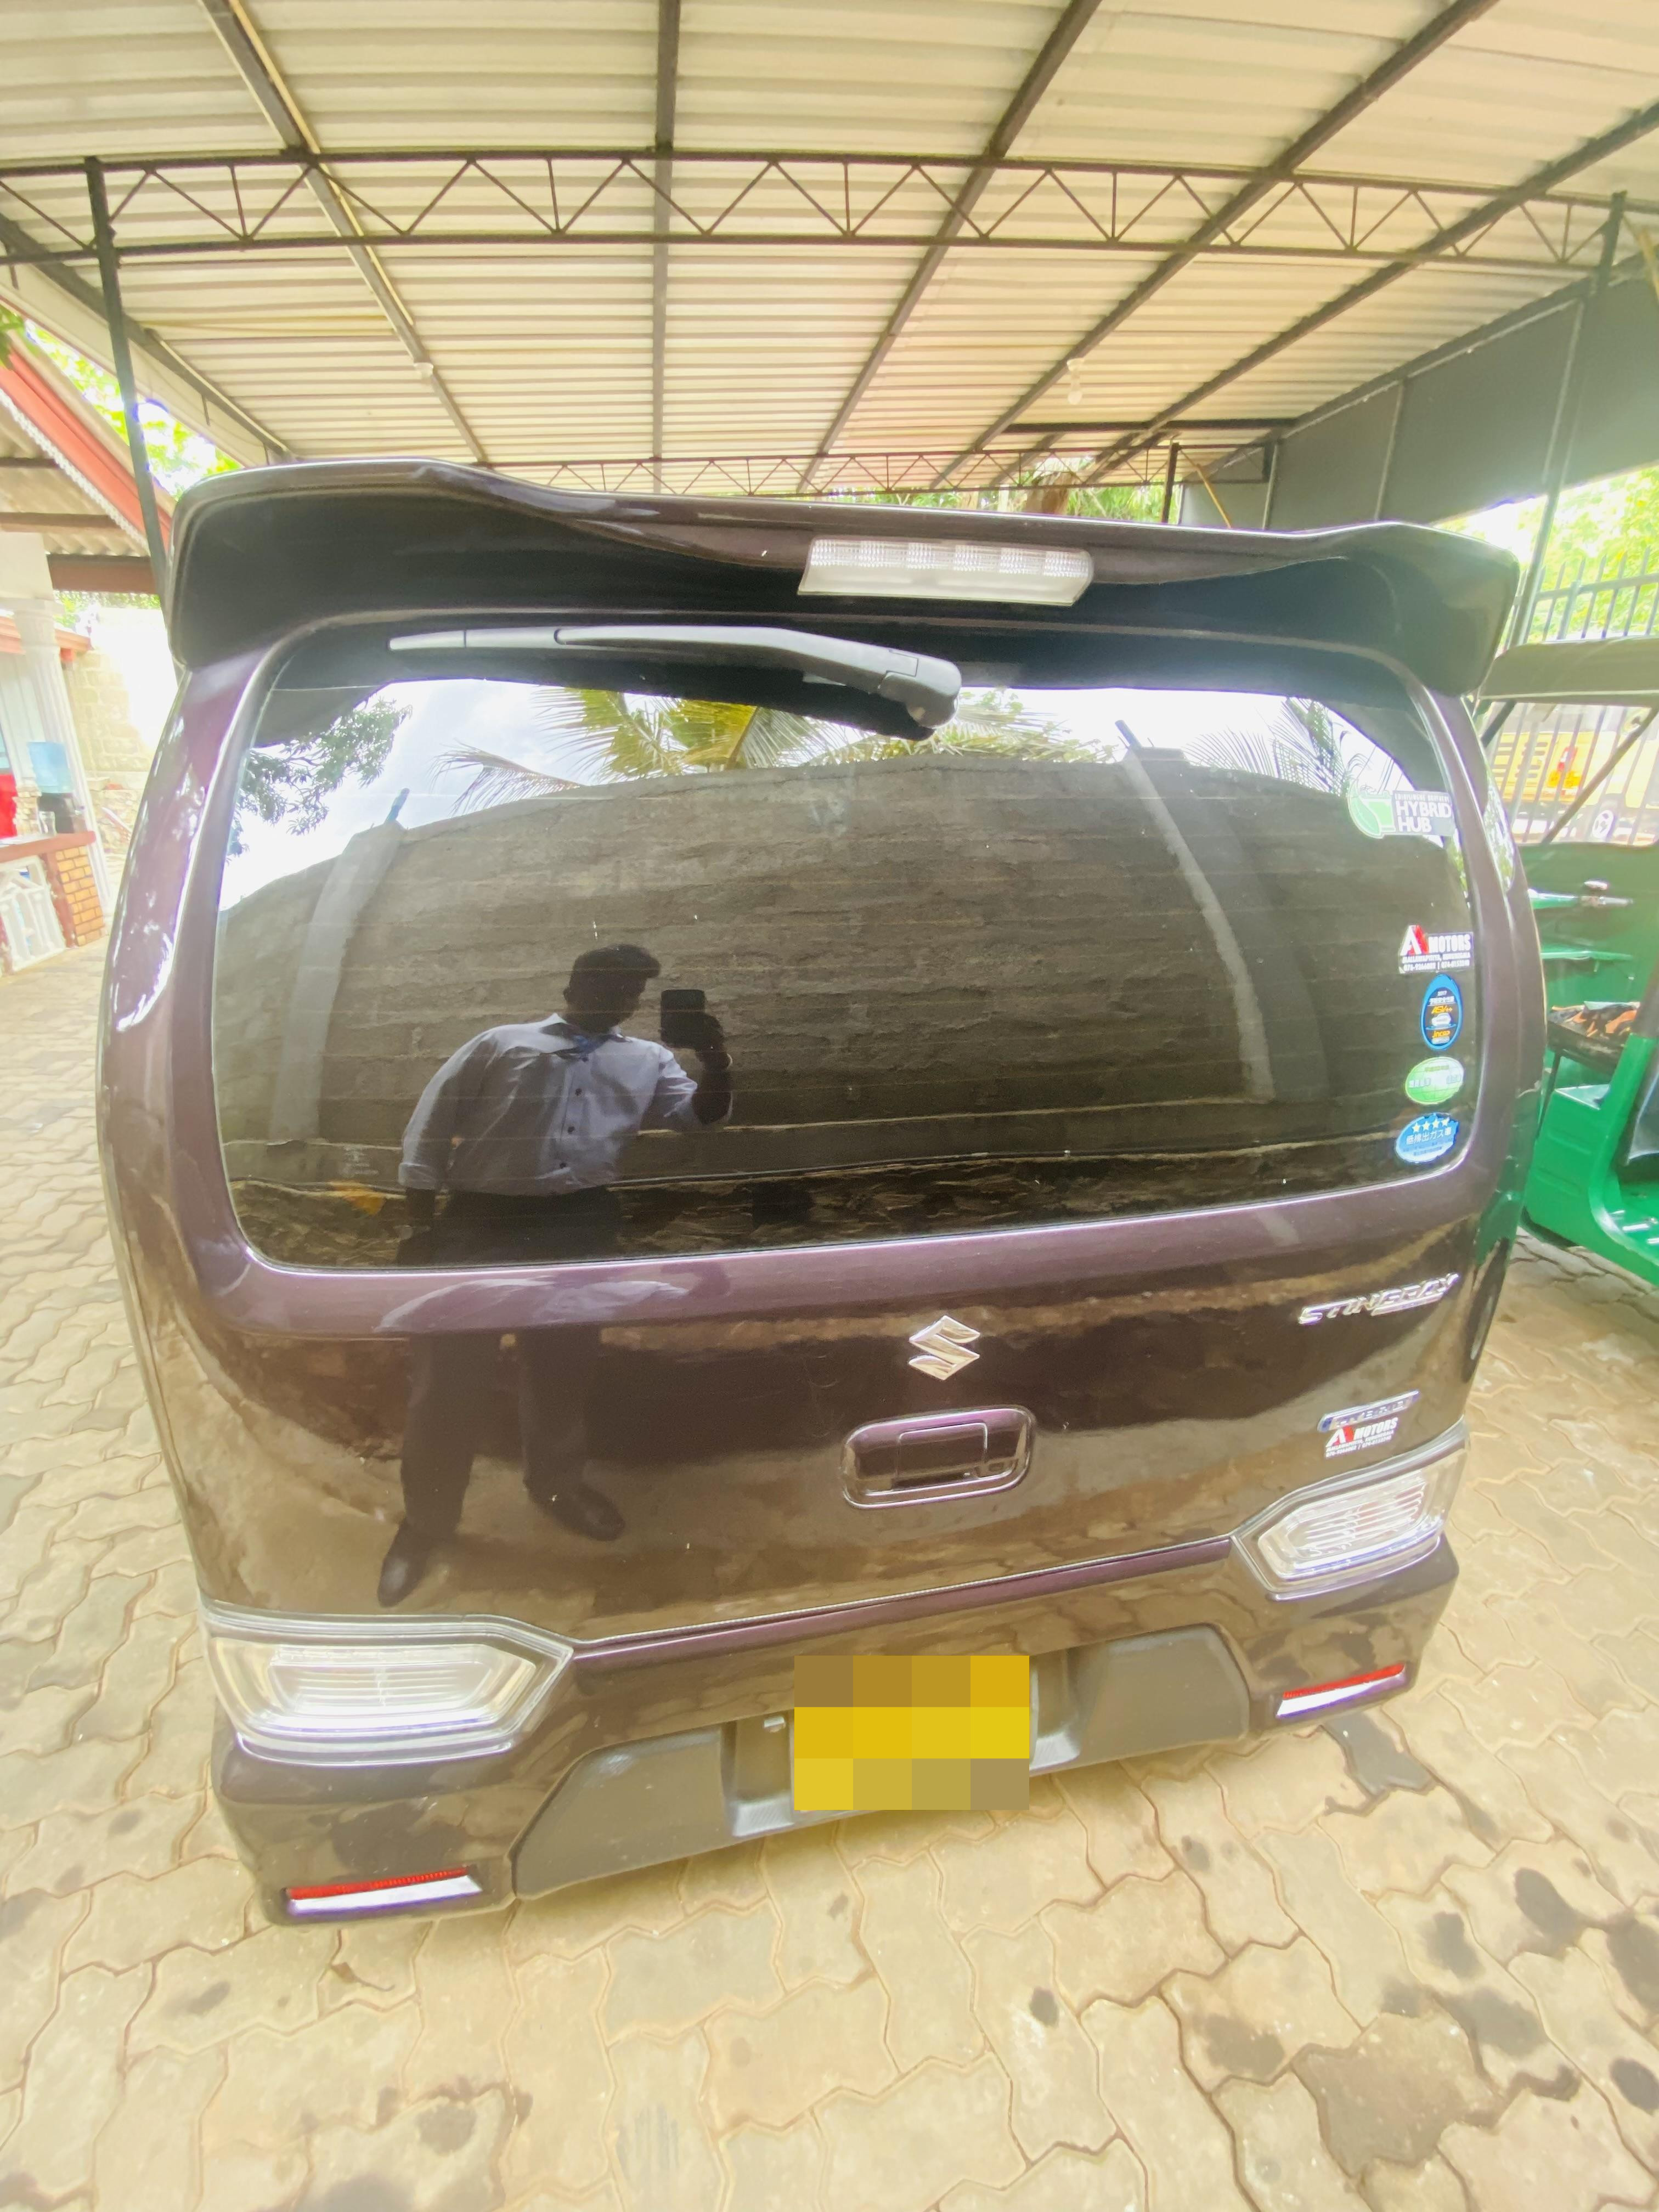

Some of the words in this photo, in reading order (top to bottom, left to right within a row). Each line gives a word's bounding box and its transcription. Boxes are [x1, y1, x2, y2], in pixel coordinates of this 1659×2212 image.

[1395, 800, 1452, 818] HYBRID
[1397, 816, 1432, 833] HUB
[1428, 934, 1471, 953] MOTORS
[1353, 1417, 1398, 1441] MOTORS
